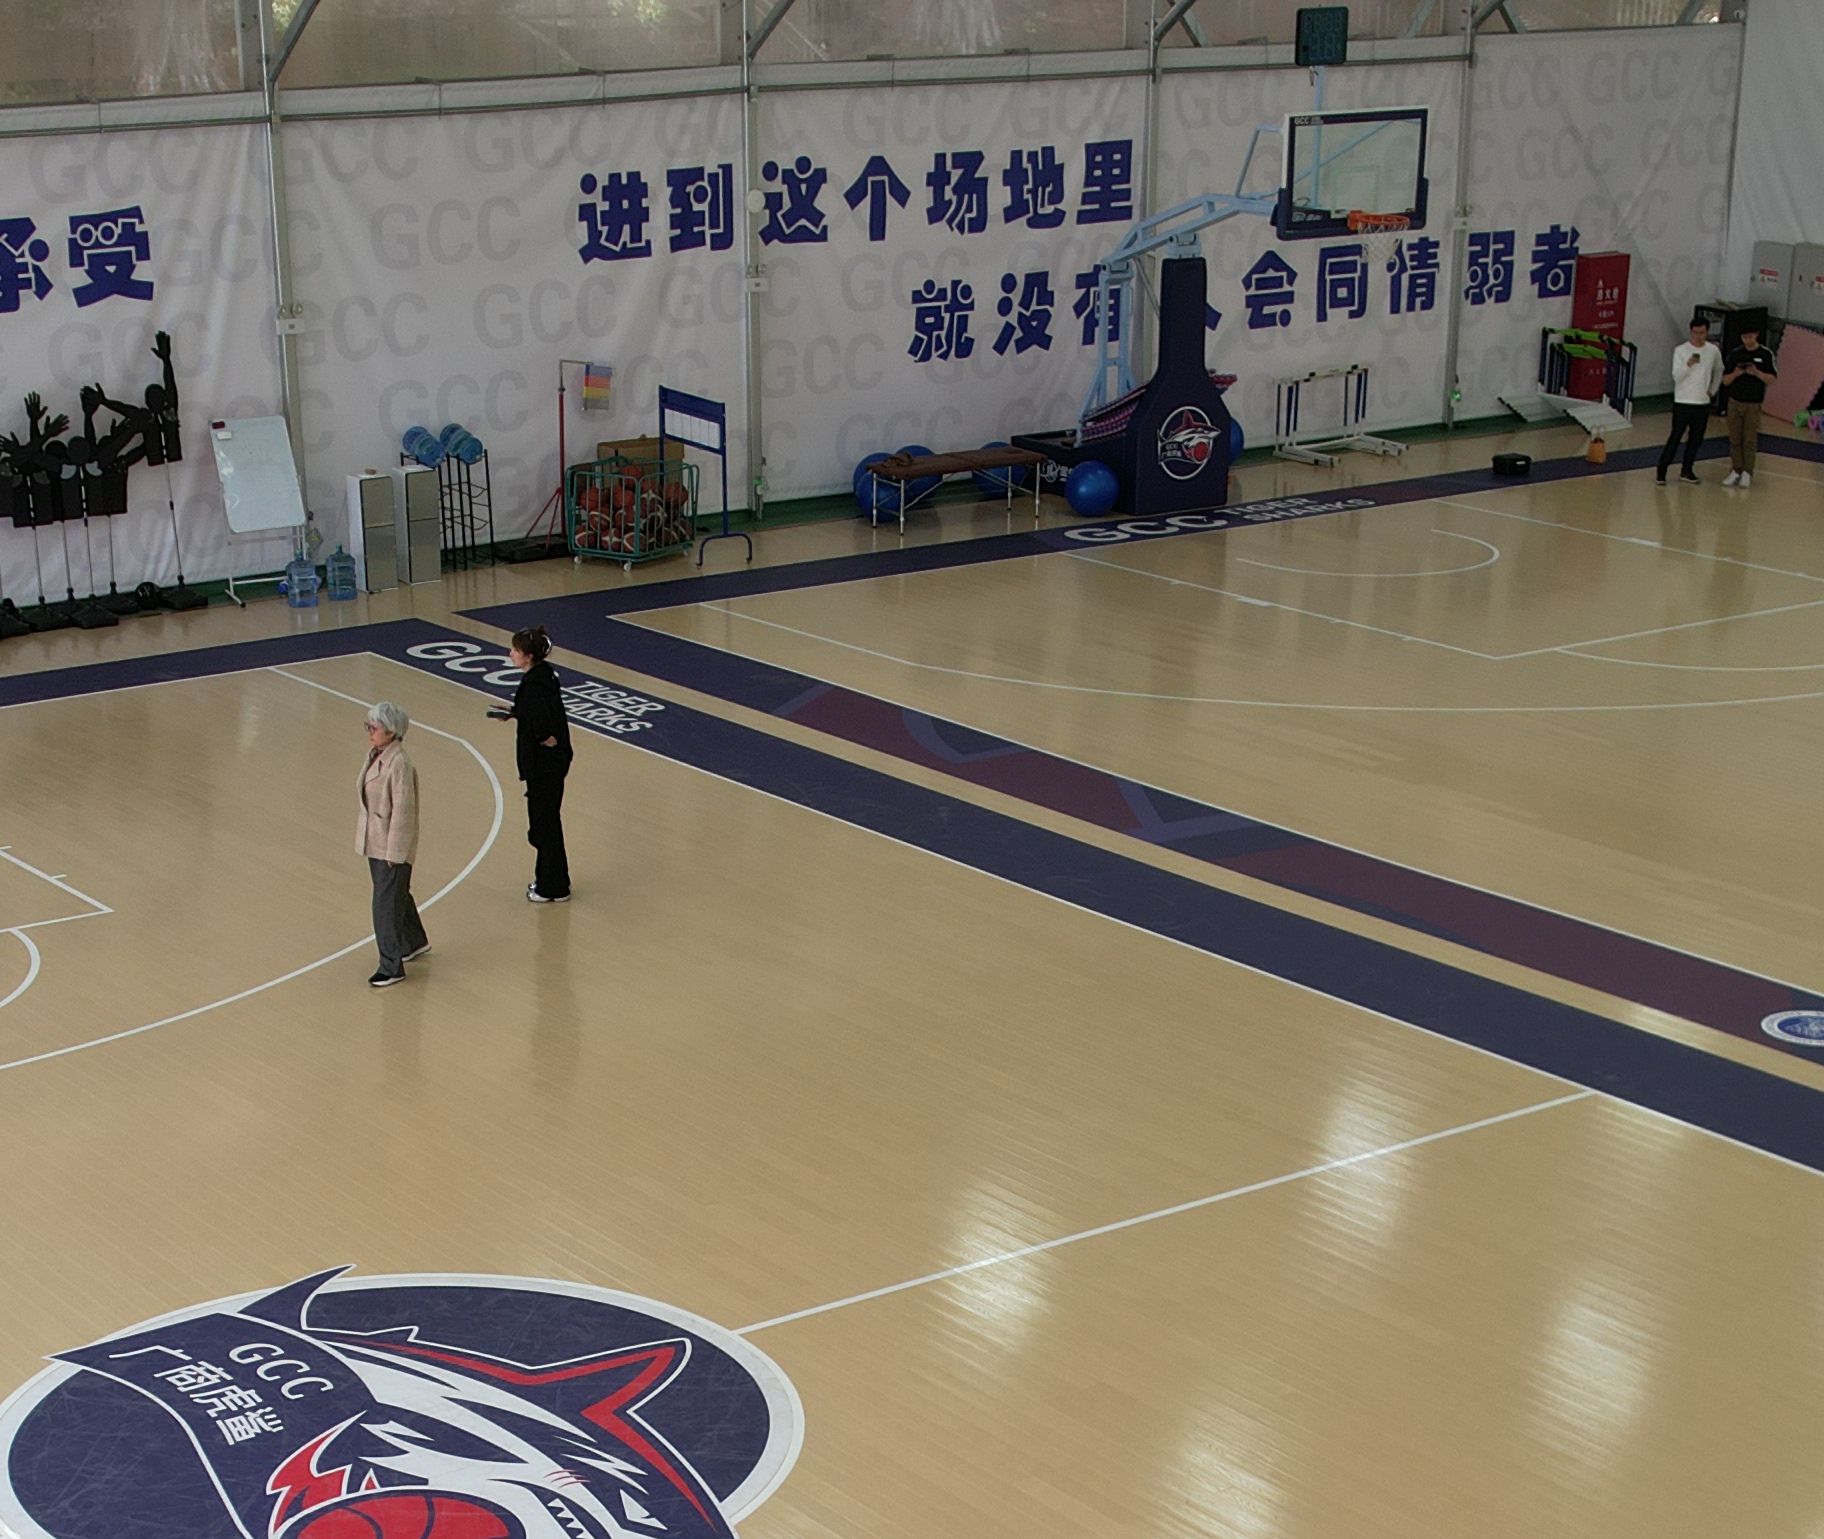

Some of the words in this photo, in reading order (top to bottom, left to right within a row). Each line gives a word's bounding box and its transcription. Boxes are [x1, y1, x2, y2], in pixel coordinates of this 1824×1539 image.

[1584, 48, 1679, 104] GCC
[462, 108, 612, 174] GCC
[843, 88, 973, 149] GCC
[1011, 82, 1129, 140] GCC
[29, 132, 200, 203] GCC
[1516, 122, 1614, 181] GCC
[577, 139, 1134, 264] 进到这个场地里
[371, 196, 522, 269] GCC
[474, 273, 618, 349] GCC
[907, 224, 1580, 363] 就没有会同情弱者
[1064, 514, 1228, 543] GCC
[1214, 498, 1319, 516] TIGER
[1243, 498, 1376, 522] SHARKS
[567, 680, 666, 717] TIGER
[109, 1344, 284, 1446] 广商虎鲨
[229, 1343, 334, 1400] GCC
